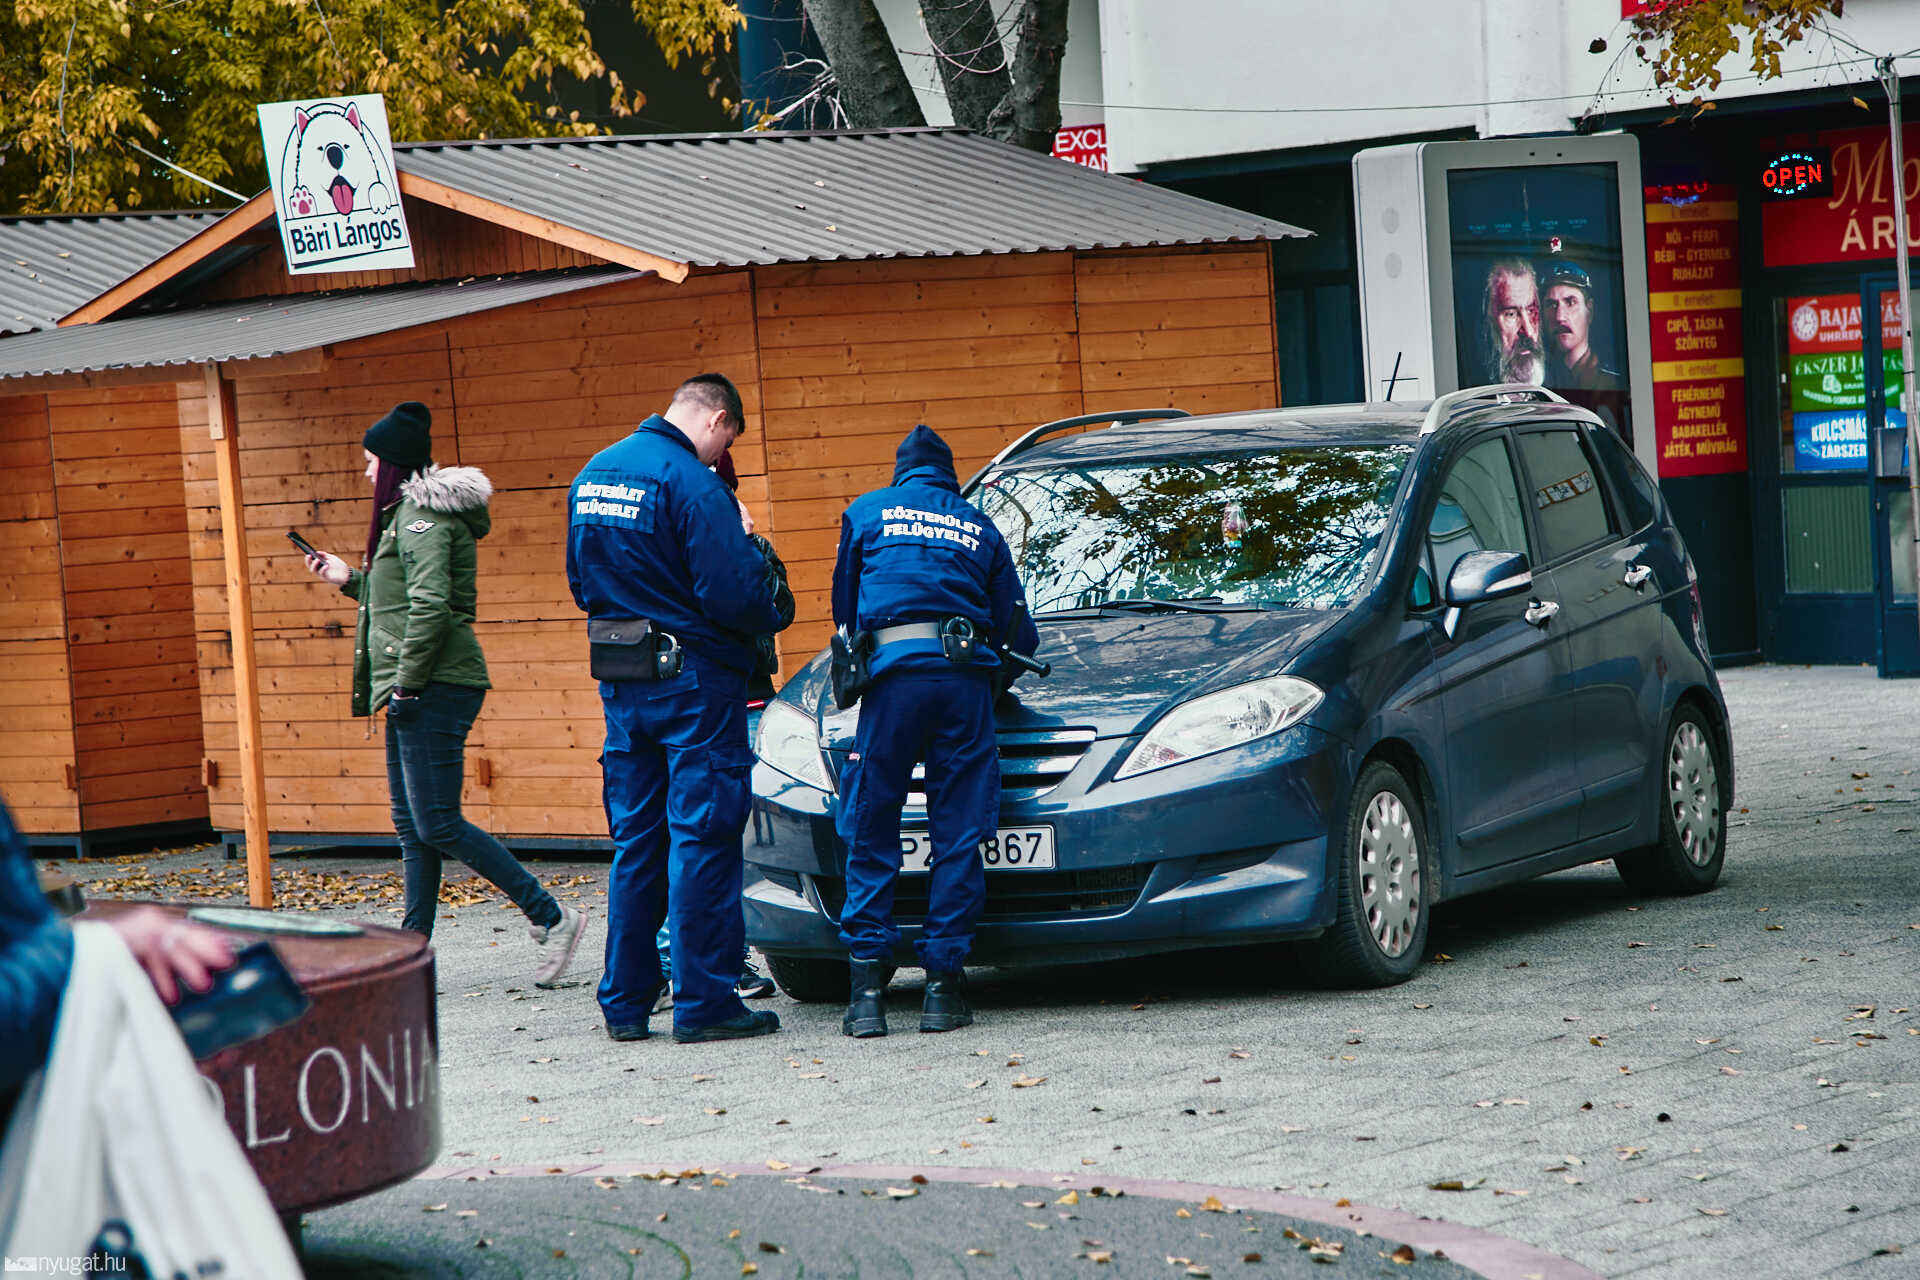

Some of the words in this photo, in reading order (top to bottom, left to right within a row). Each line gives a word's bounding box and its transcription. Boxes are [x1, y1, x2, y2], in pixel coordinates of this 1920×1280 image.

[1763, 163, 1822, 187] OPEN
[290, 222, 331, 255] Bäri
[333, 216, 402, 249] Lángos
[1687, 247, 1731, 261] GYERMEK
[1672, 263, 1714, 280] RUHÁZAT
[1694, 315, 1724, 331] TÁSKA
[1795, 356, 1847, 376] ÉKSZER
[1672, 421, 1728, 440] BABAKELLÉK
[881, 505, 983, 536] KÖZTERÜLET
[883, 521, 980, 552] FELÜGYELET
